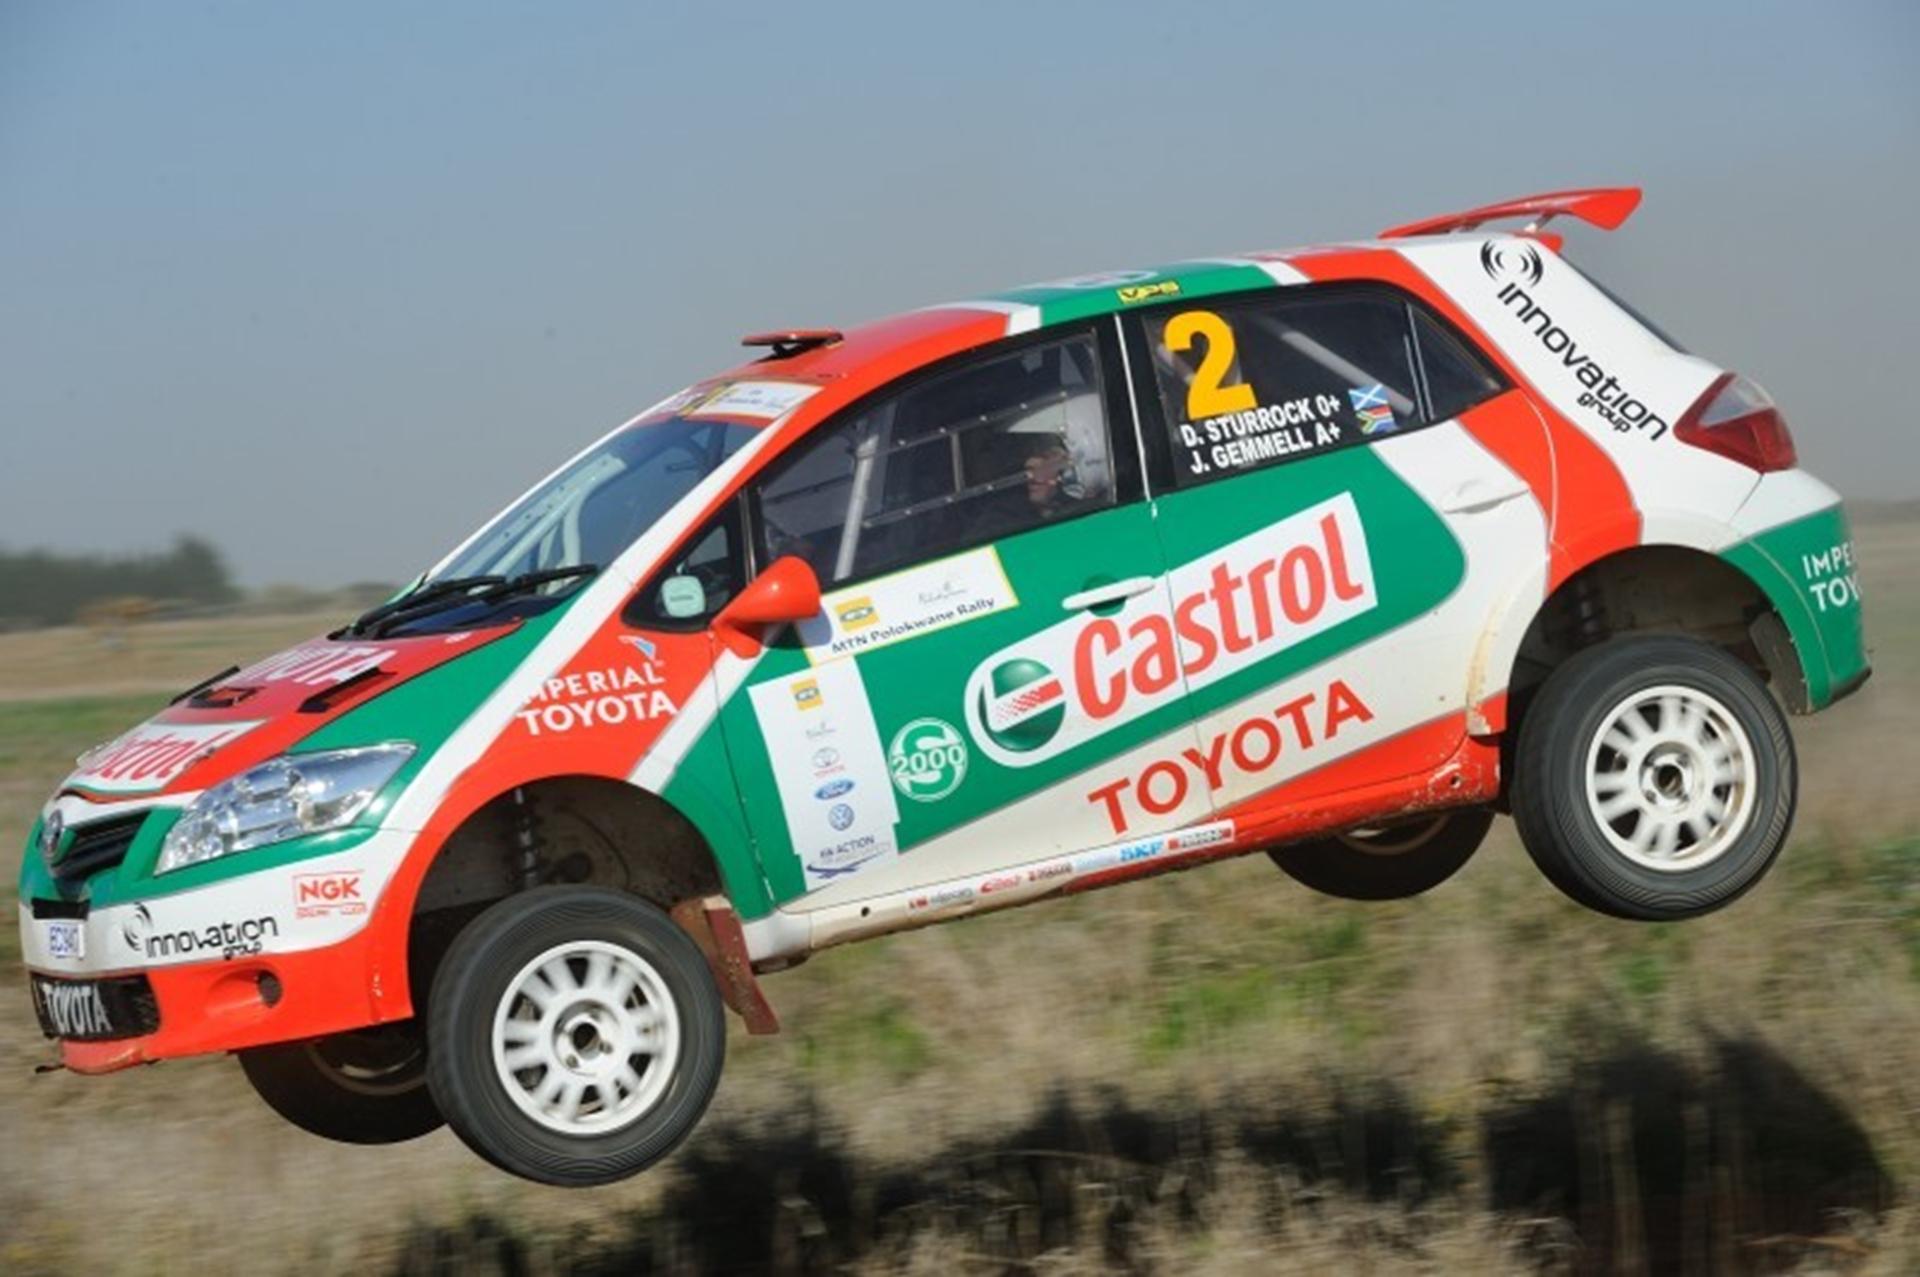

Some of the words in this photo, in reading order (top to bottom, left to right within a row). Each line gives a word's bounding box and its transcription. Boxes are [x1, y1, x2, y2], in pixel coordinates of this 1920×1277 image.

[1163, 311, 1257, 420] 2
[1497, 282, 1668, 441] innovation
[1180, 423, 1205, 448] D.
[1205, 398, 1315, 443] STURROCK
[1576, 391, 1632, 433] group
[1189, 451, 1211, 474] J.
[1211, 428, 1314, 468] GEMMELL
[1315, 422, 1341, 446] A+
[832, 634, 868, 653] MTN
[870, 610, 955, 641] Polokwane
[956, 597, 996, 616] Rally
[1074, 512, 1364, 720] Castrol
[525, 662, 666, 704] PERIAL
[516, 689, 679, 736] TOYOTA
[892, 745, 964, 775] 2000
[1087, 679, 1374, 834] TOYOTA
[300, 877, 361, 903] NGK
[145, 915, 279, 958] innovation
[222, 941, 262, 960] group
[41, 981, 113, 1035] TOYOTA
